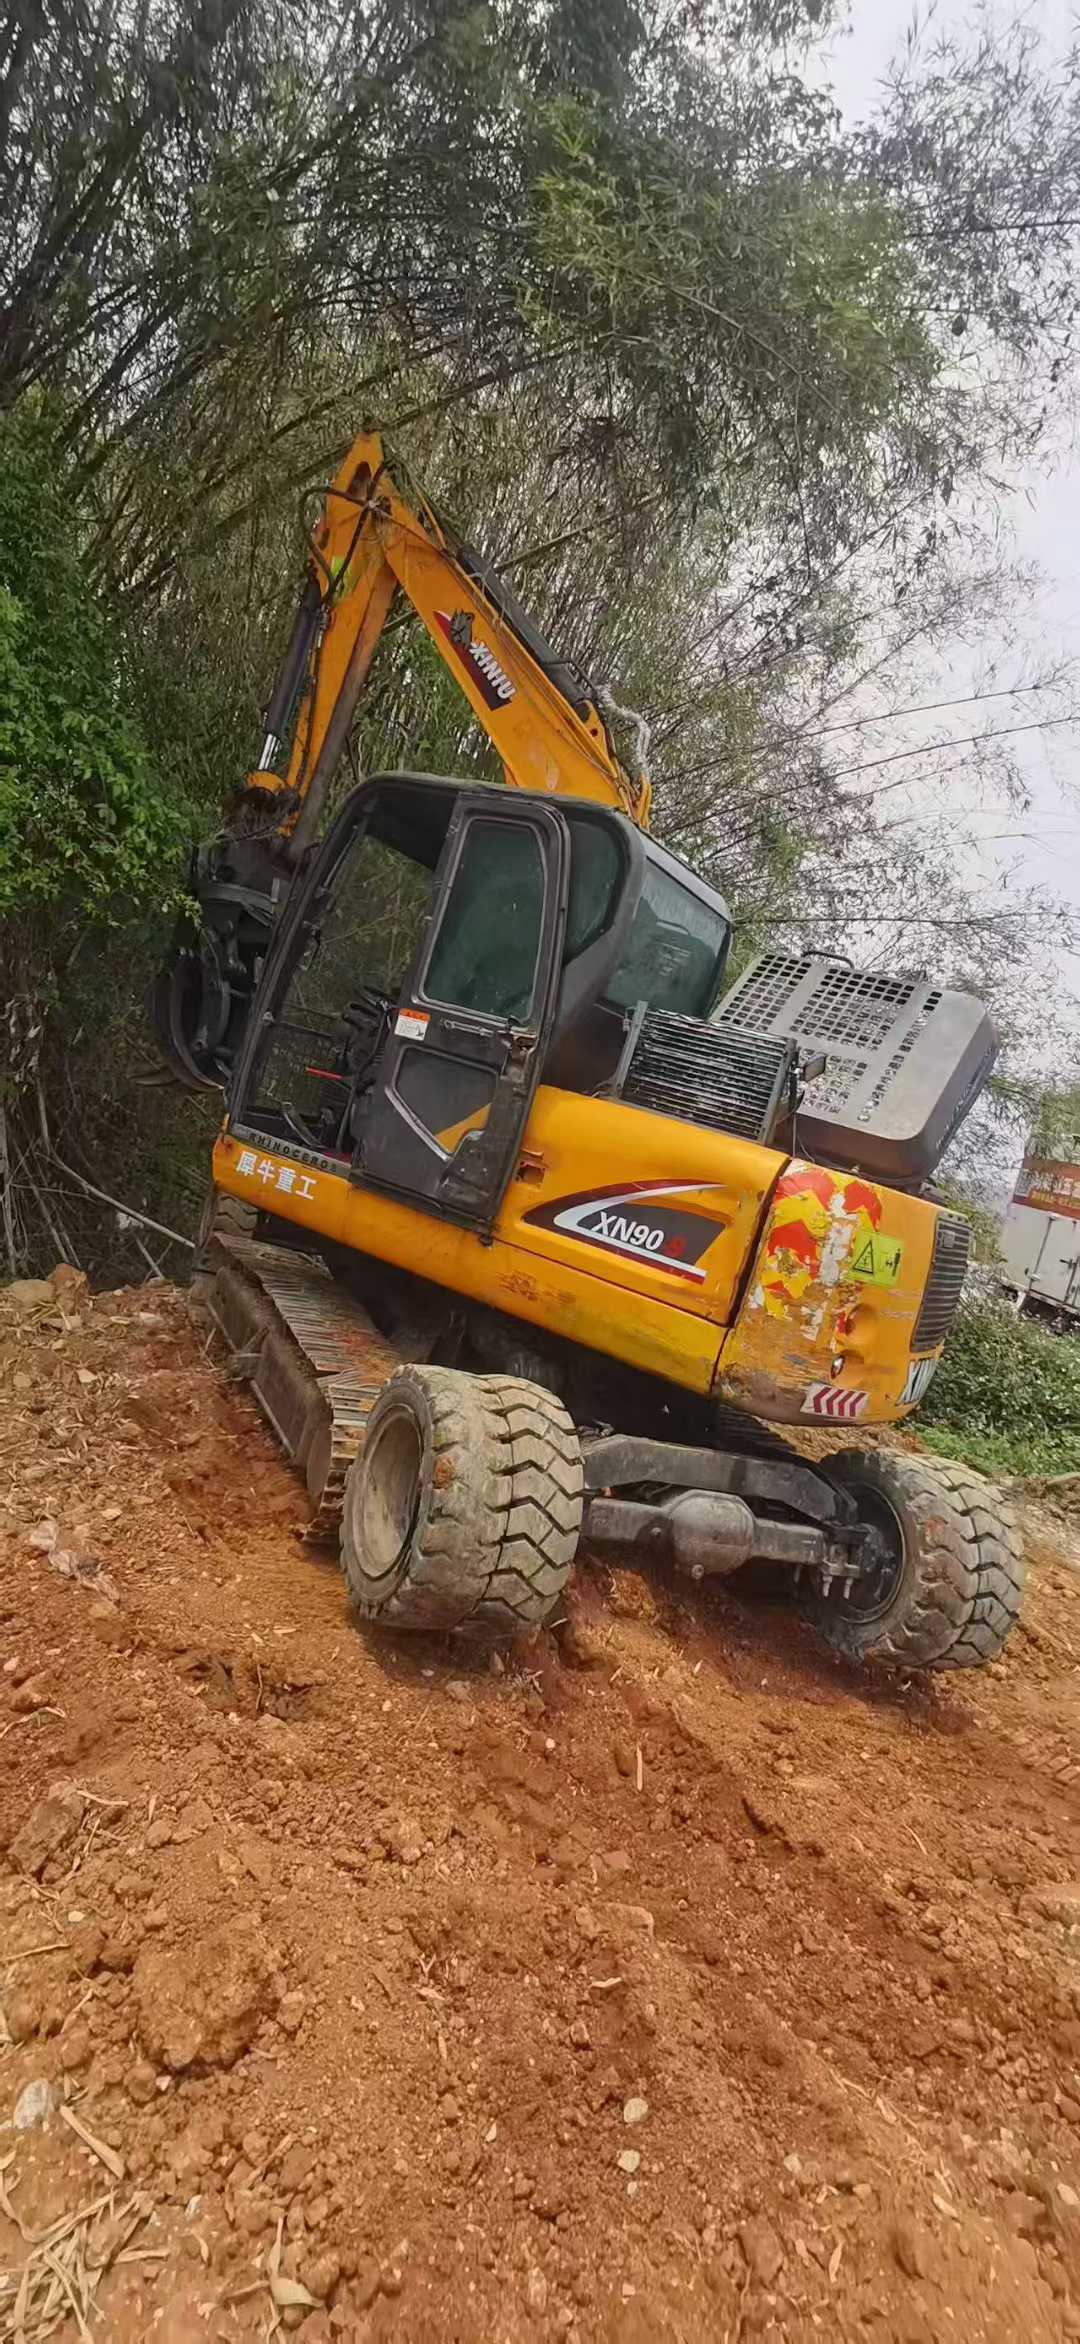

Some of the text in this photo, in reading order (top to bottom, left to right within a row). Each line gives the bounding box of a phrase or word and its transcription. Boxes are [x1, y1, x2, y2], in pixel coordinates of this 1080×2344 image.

[469, 641, 516, 700] XINIU
[235, 1150, 318, 1201] 犀牛重工
[248, 1132, 338, 1173] RHINOCEROS
